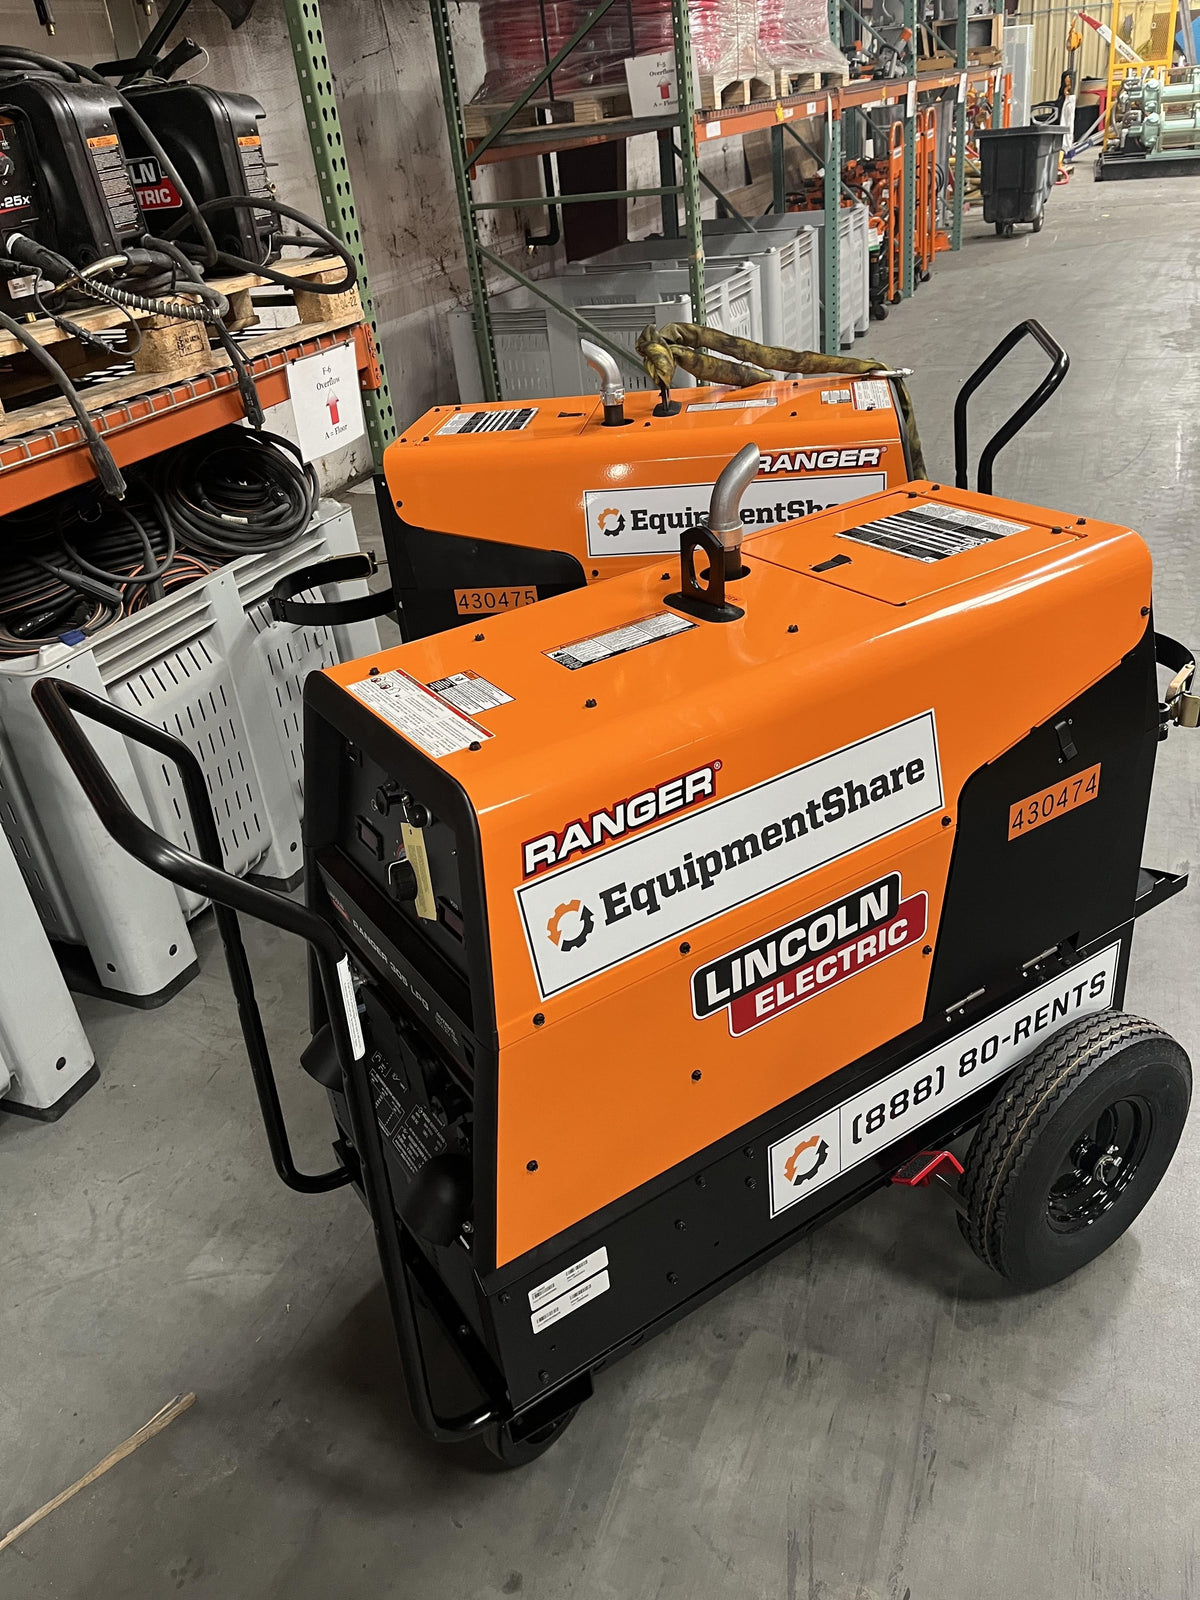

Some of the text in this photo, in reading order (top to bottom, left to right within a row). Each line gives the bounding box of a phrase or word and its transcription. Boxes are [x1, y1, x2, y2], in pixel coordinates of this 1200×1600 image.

[649, 68, 675, 77] Overflow
[136, 188, 171, 206] TRIC
[316, 377, 340, 391] Overflow
[334, 424, 348, 435] Floor
[631, 499, 840, 535] EquientSh
[458, 590, 536, 610] 430475
[1011, 772, 1097, 830] 430474
[598, 757, 926, 927] EquipmentShare
[705, 884, 890, 1008] LINCOLN
[754, 918, 910, 1018] ELECTRIC
[852, 970, 1107, 1145] (888) 80-RENTS
